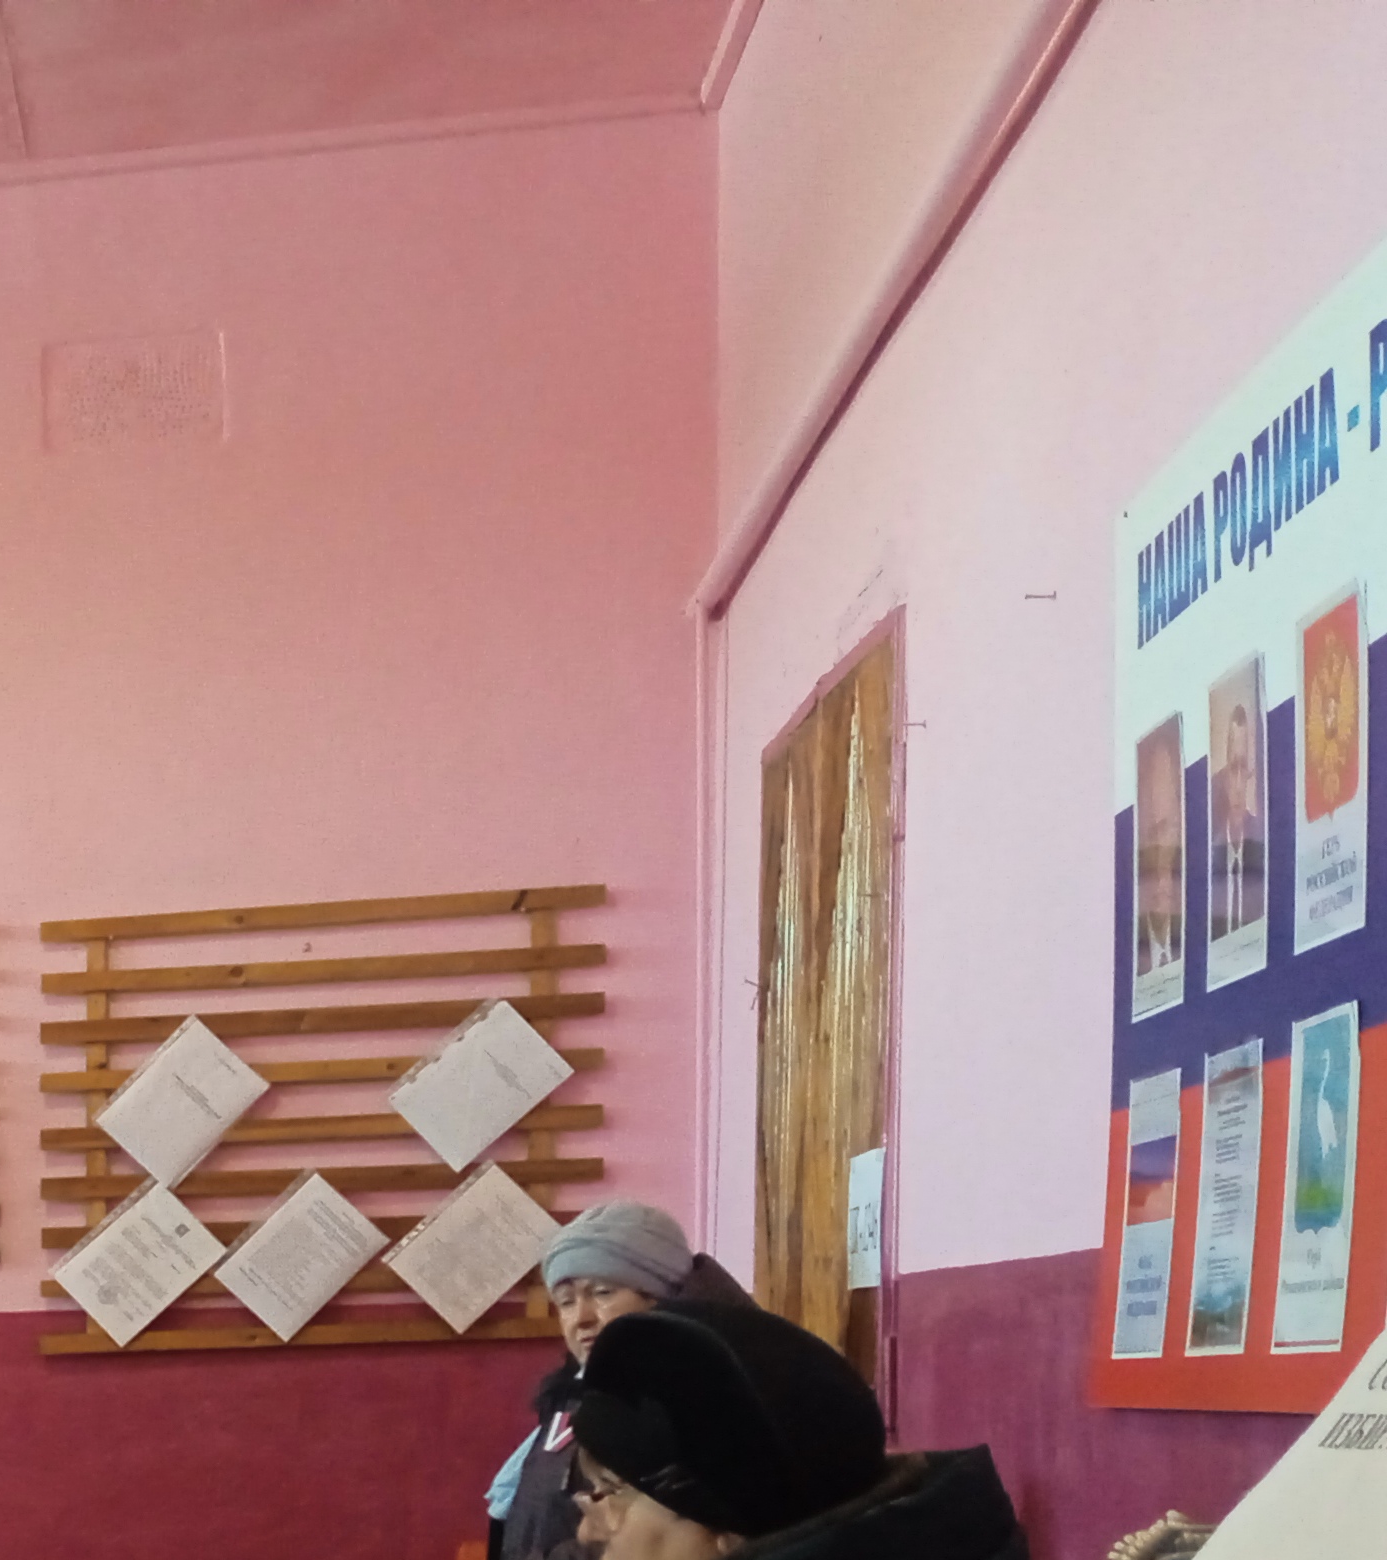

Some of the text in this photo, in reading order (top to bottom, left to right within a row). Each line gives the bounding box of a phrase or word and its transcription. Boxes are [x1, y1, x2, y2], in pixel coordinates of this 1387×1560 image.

[1137, 490, 1208, 650] НАША
[1213, 367, 1340, 584] РОДИНА
[1369, 318, 1387, 453] Р
